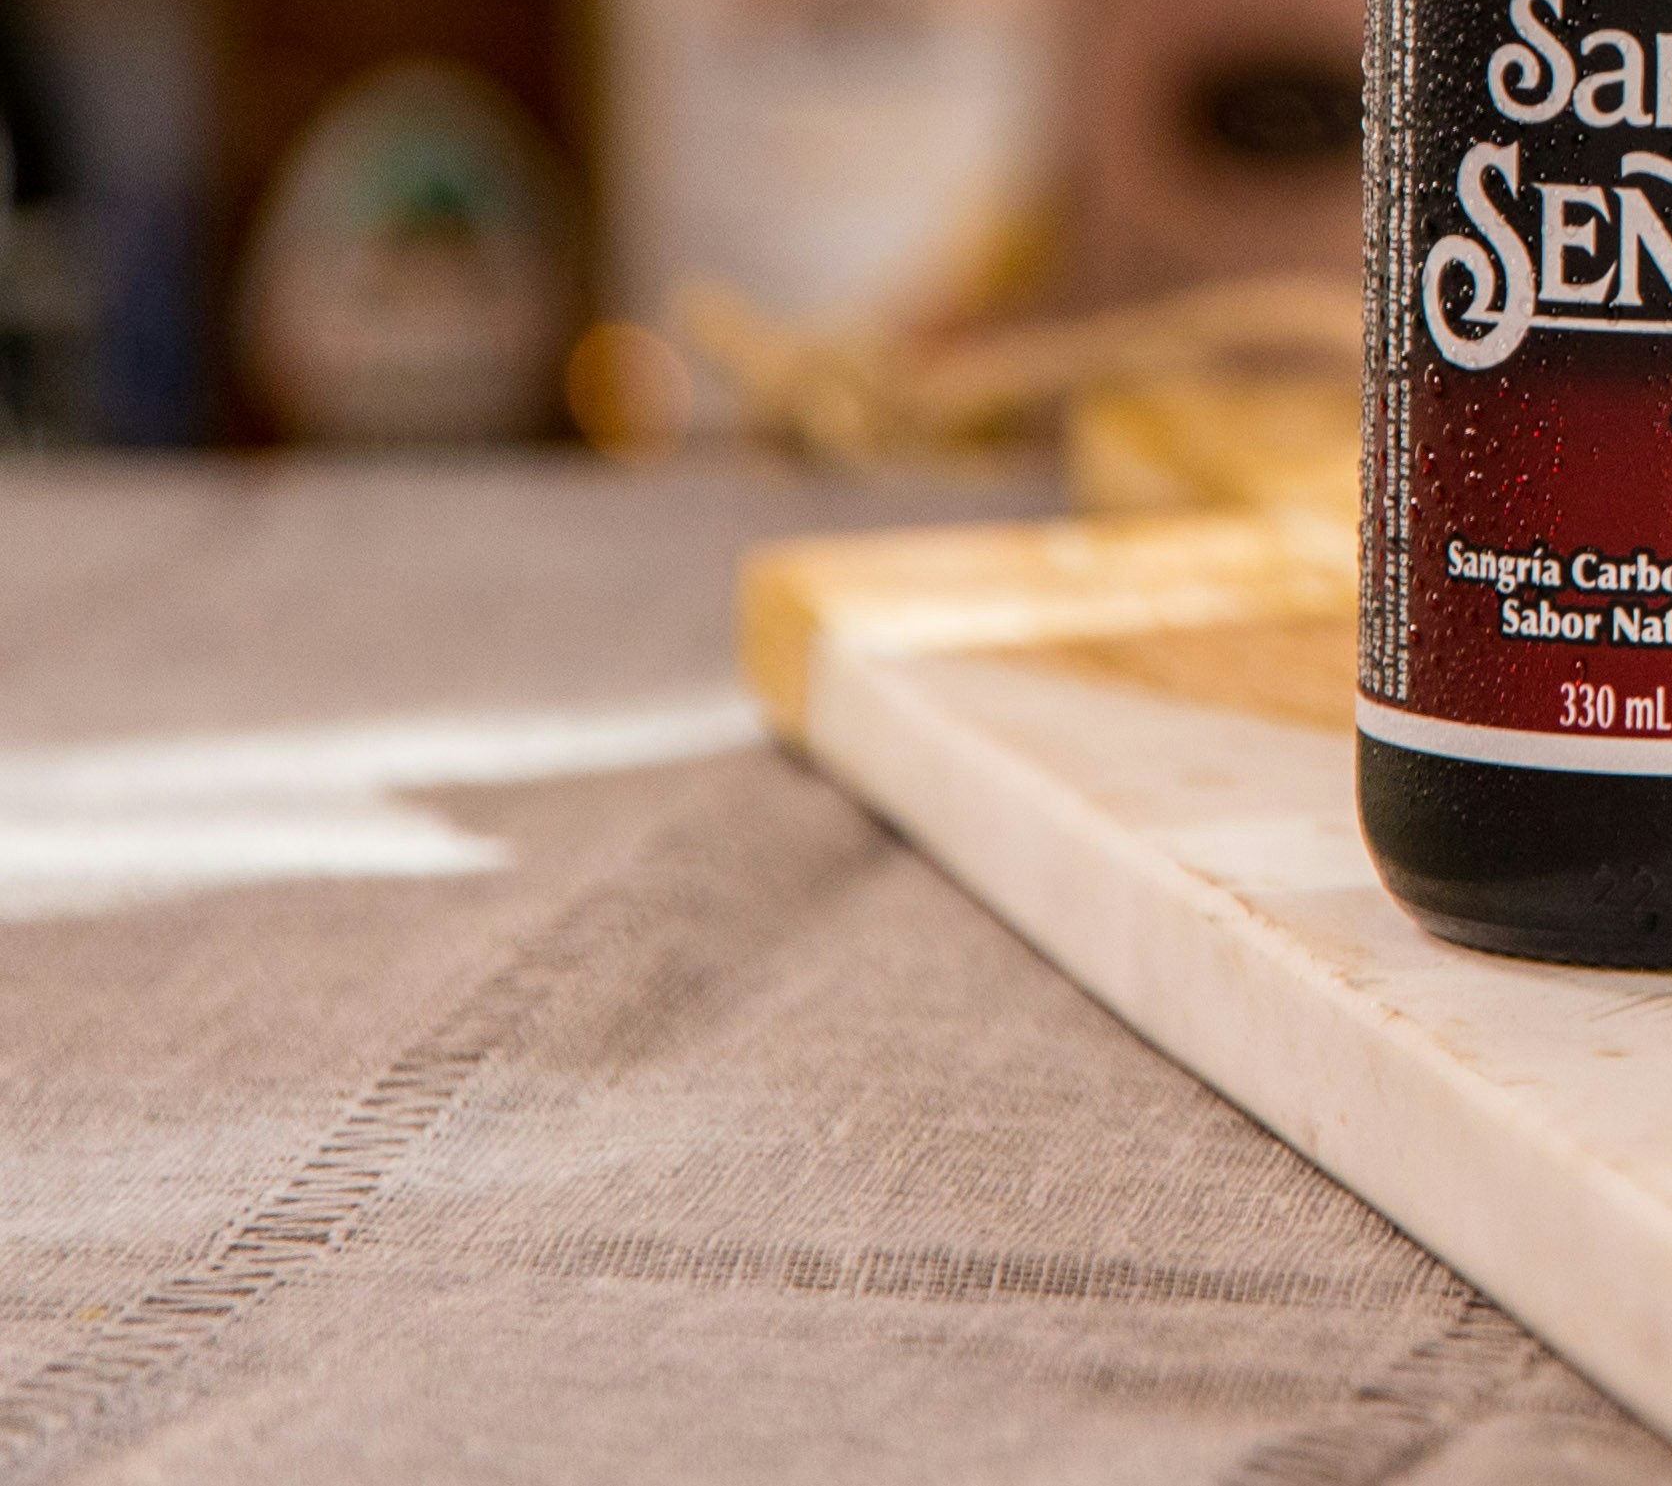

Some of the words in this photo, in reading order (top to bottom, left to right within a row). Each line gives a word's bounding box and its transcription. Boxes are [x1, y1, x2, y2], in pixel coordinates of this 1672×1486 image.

[1399, 379, 1411, 450] MEXICO
[1398, 479, 1410, 540] HECHO
[1447, 540, 1562, 594] Sangría
[1501, 598, 1602, 641] Sabor
[1396, 648, 1409, 701] MADE
[1559, 682, 1617, 729] 330
[1625, 685, 1672, 731] mL
